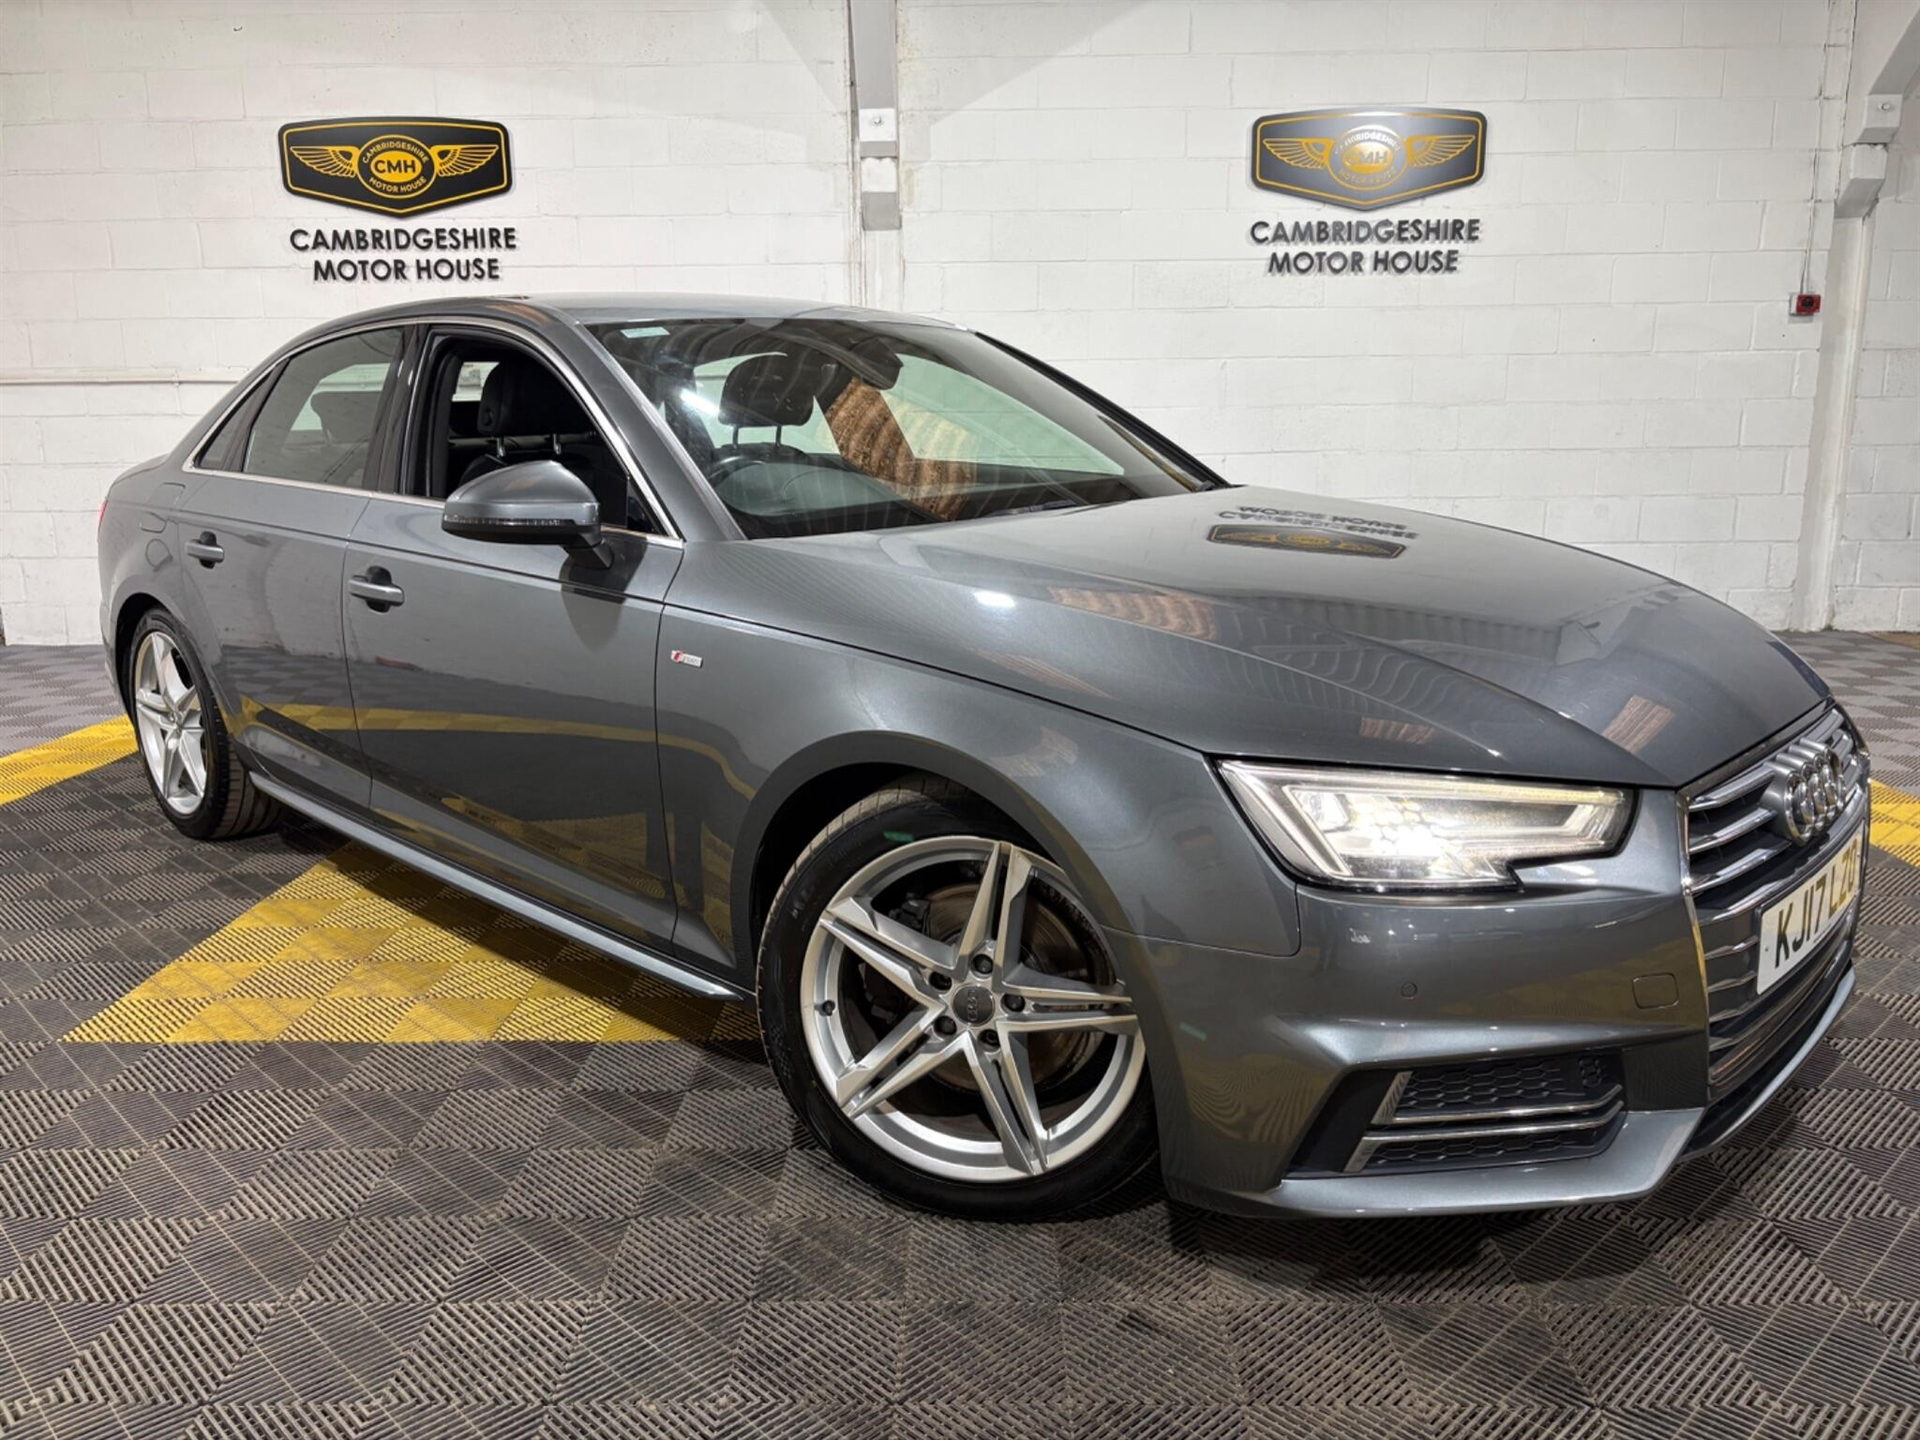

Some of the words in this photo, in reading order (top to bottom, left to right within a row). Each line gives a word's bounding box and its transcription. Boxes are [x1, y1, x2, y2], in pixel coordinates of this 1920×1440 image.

[362, 141, 429, 164] CAMBRIDGESHIRE
[374, 159, 416, 174] CMH
[369, 177, 399, 193] MOTOR
[400, 176, 427, 193] HOUSE
[290, 228, 516, 251] CAMBRIDGESHIRE
[1250, 219, 1480, 243] CAMBRIDGESHIRE
[314, 259, 407, 282] MOTOR
[416, 258, 500, 280] HOUSE
[1268, 250, 1363, 272] MOTOR
[1373, 250, 1458, 272] HOUSE
[1775, 874, 1827, 968] KJ17
